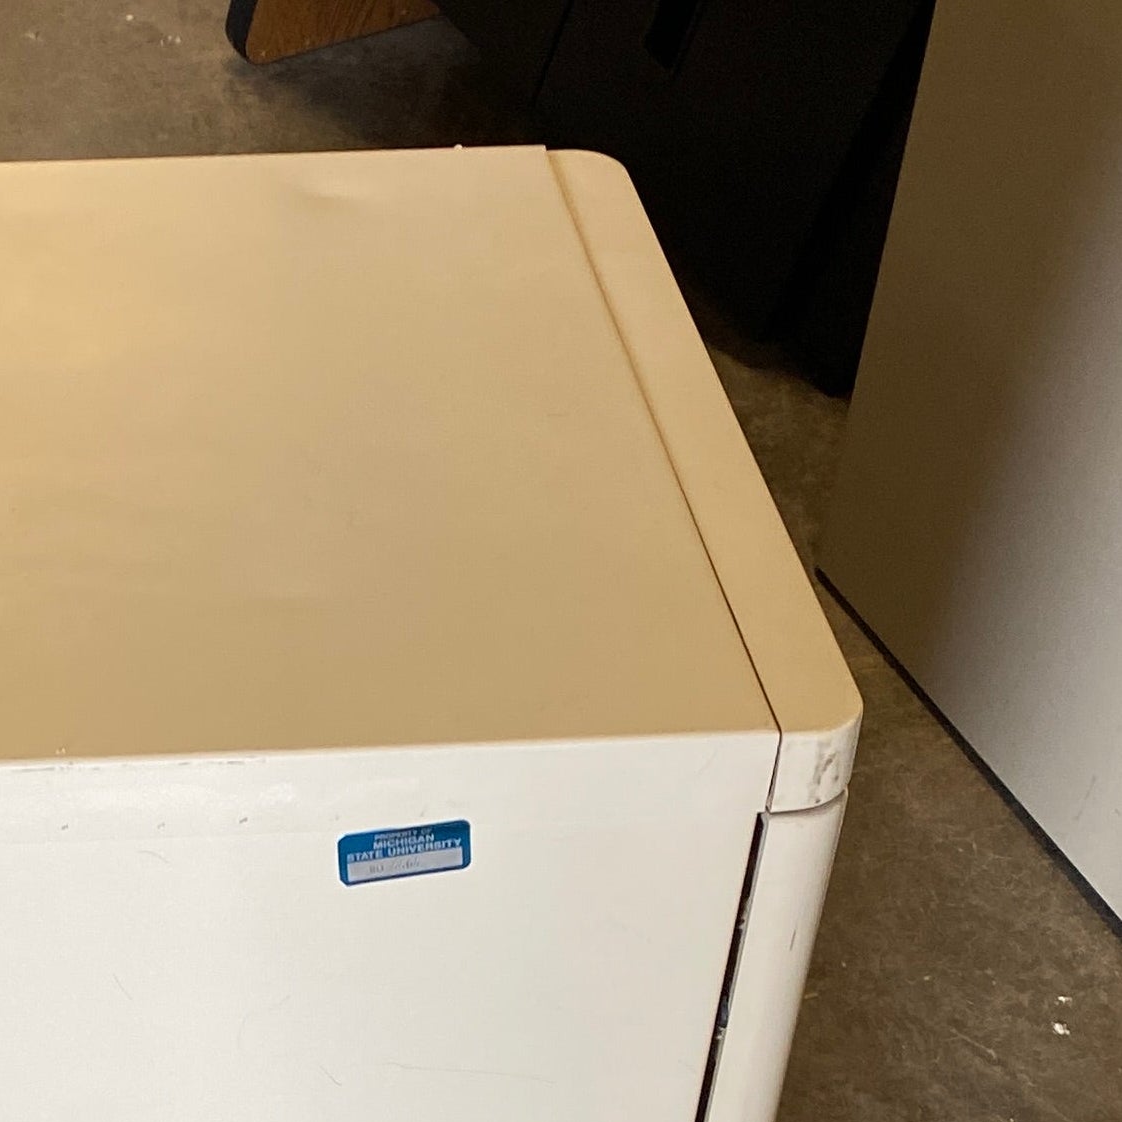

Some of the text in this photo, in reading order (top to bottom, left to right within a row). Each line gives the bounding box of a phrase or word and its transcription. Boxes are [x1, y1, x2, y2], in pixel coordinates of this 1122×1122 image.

[347, 838, 462, 863] STATE UNIVERSITY
[373, 833, 435, 850] MICHIGAN
